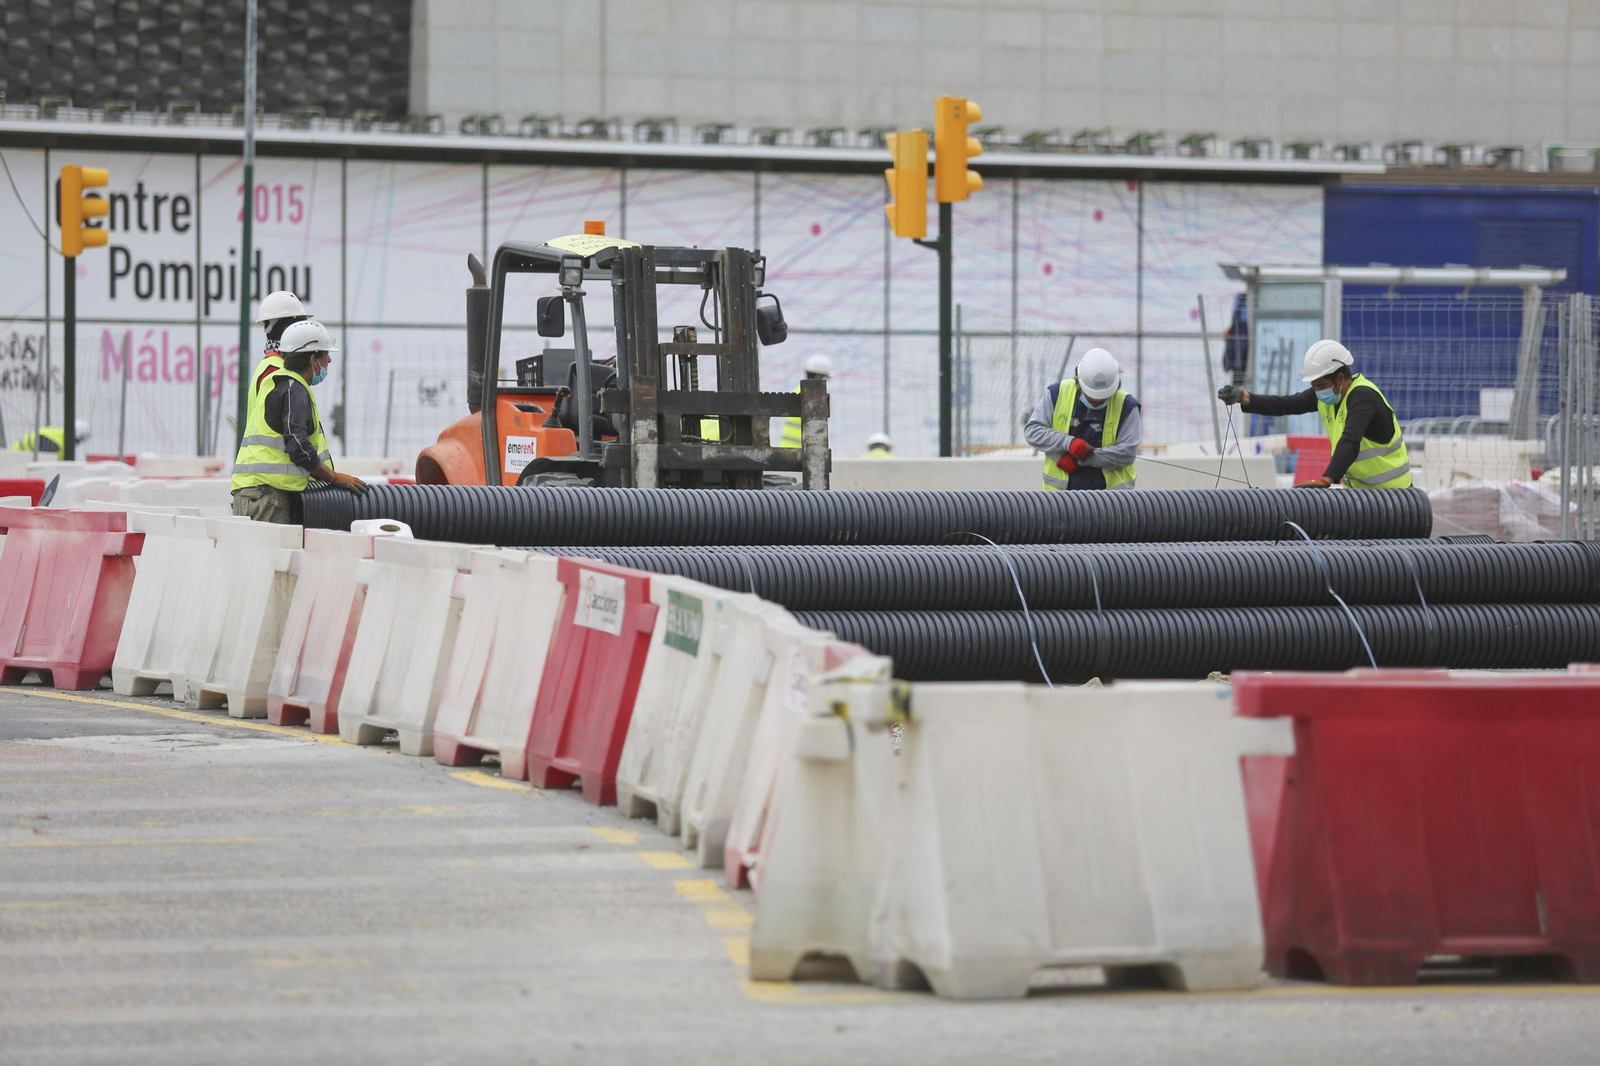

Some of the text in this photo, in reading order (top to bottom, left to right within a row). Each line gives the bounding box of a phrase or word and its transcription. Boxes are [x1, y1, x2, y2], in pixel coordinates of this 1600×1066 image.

[108, 246, 312, 317] Pompidou
[101, 328, 241, 398] Málaga
[508, 441, 534, 454] emerent
[591, 591, 617, 614] acciona
